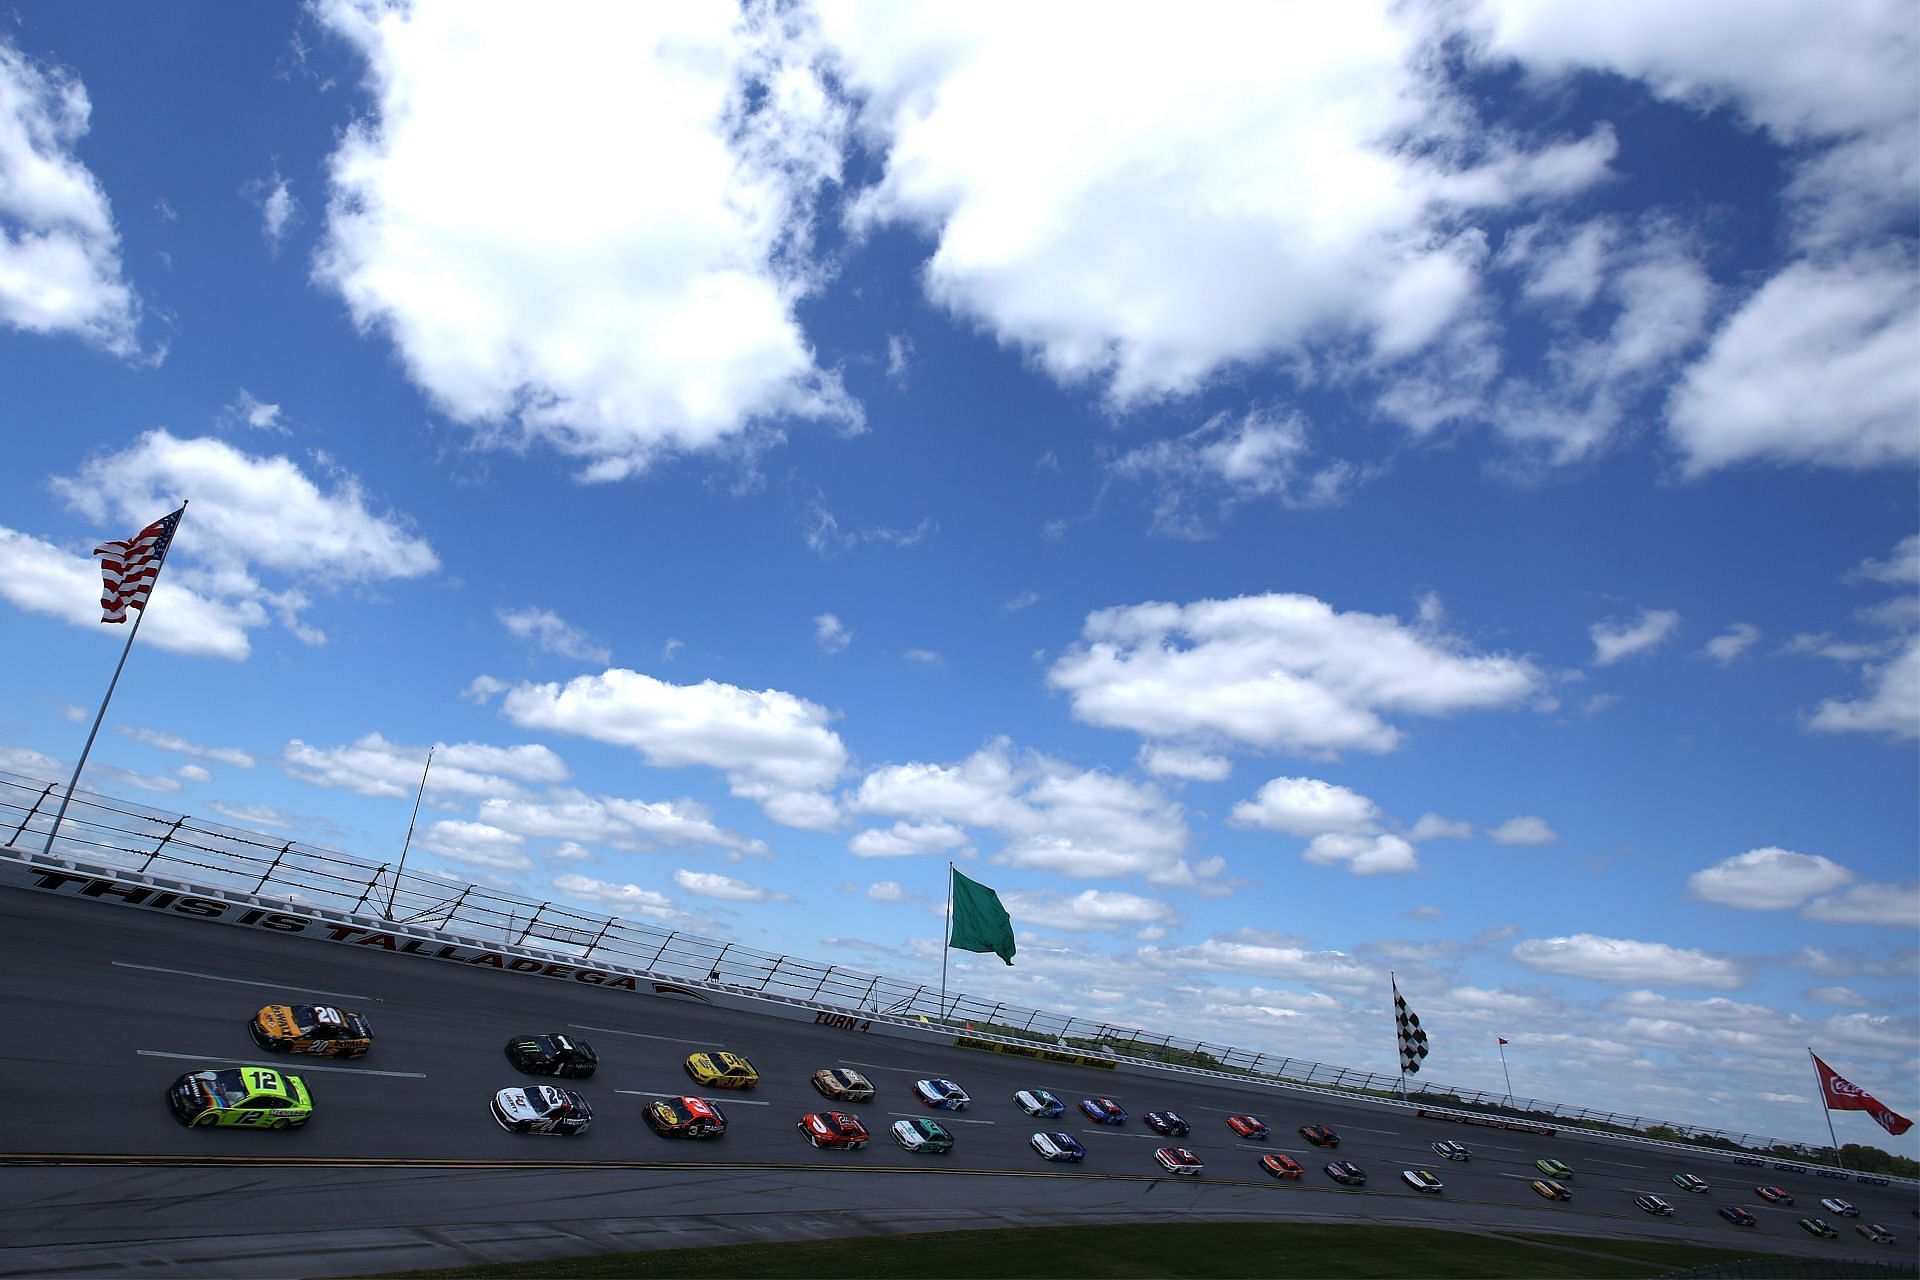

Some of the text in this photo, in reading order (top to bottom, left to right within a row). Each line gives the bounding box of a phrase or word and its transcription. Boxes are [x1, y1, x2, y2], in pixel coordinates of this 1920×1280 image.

[32, 868, 636, 991] THIS IS TALLADEGA
[315, 1007, 341, 1024] 20
[815, 1011, 871, 1032] TURN 4
[309, 1040, 329, 1052] 20
[557, 1035, 573, 1050] 1
[958, 1037, 995, 1051] YellaWood
[1002, 1044, 1037, 1057] YellaWood
[723, 1053, 741, 1066] 34
[554, 1062, 564, 1075] 1
[250, 1072, 276, 1089] 12
[504, 1092, 518, 1113] LIBERTY
[684, 1097, 709, 1114] 3
[234, 1111, 263, 1124] 12
[1149, 1112, 1168, 1127] ally
[689, 1126, 698, 1136] 3
[1736, 1157, 1765, 1167] GEICO
[1775, 1163, 1807, 1173] GEICO
[1817, 1170, 1849, 1180] GEICO
[1858, 1176, 1889, 1186] GEICO
